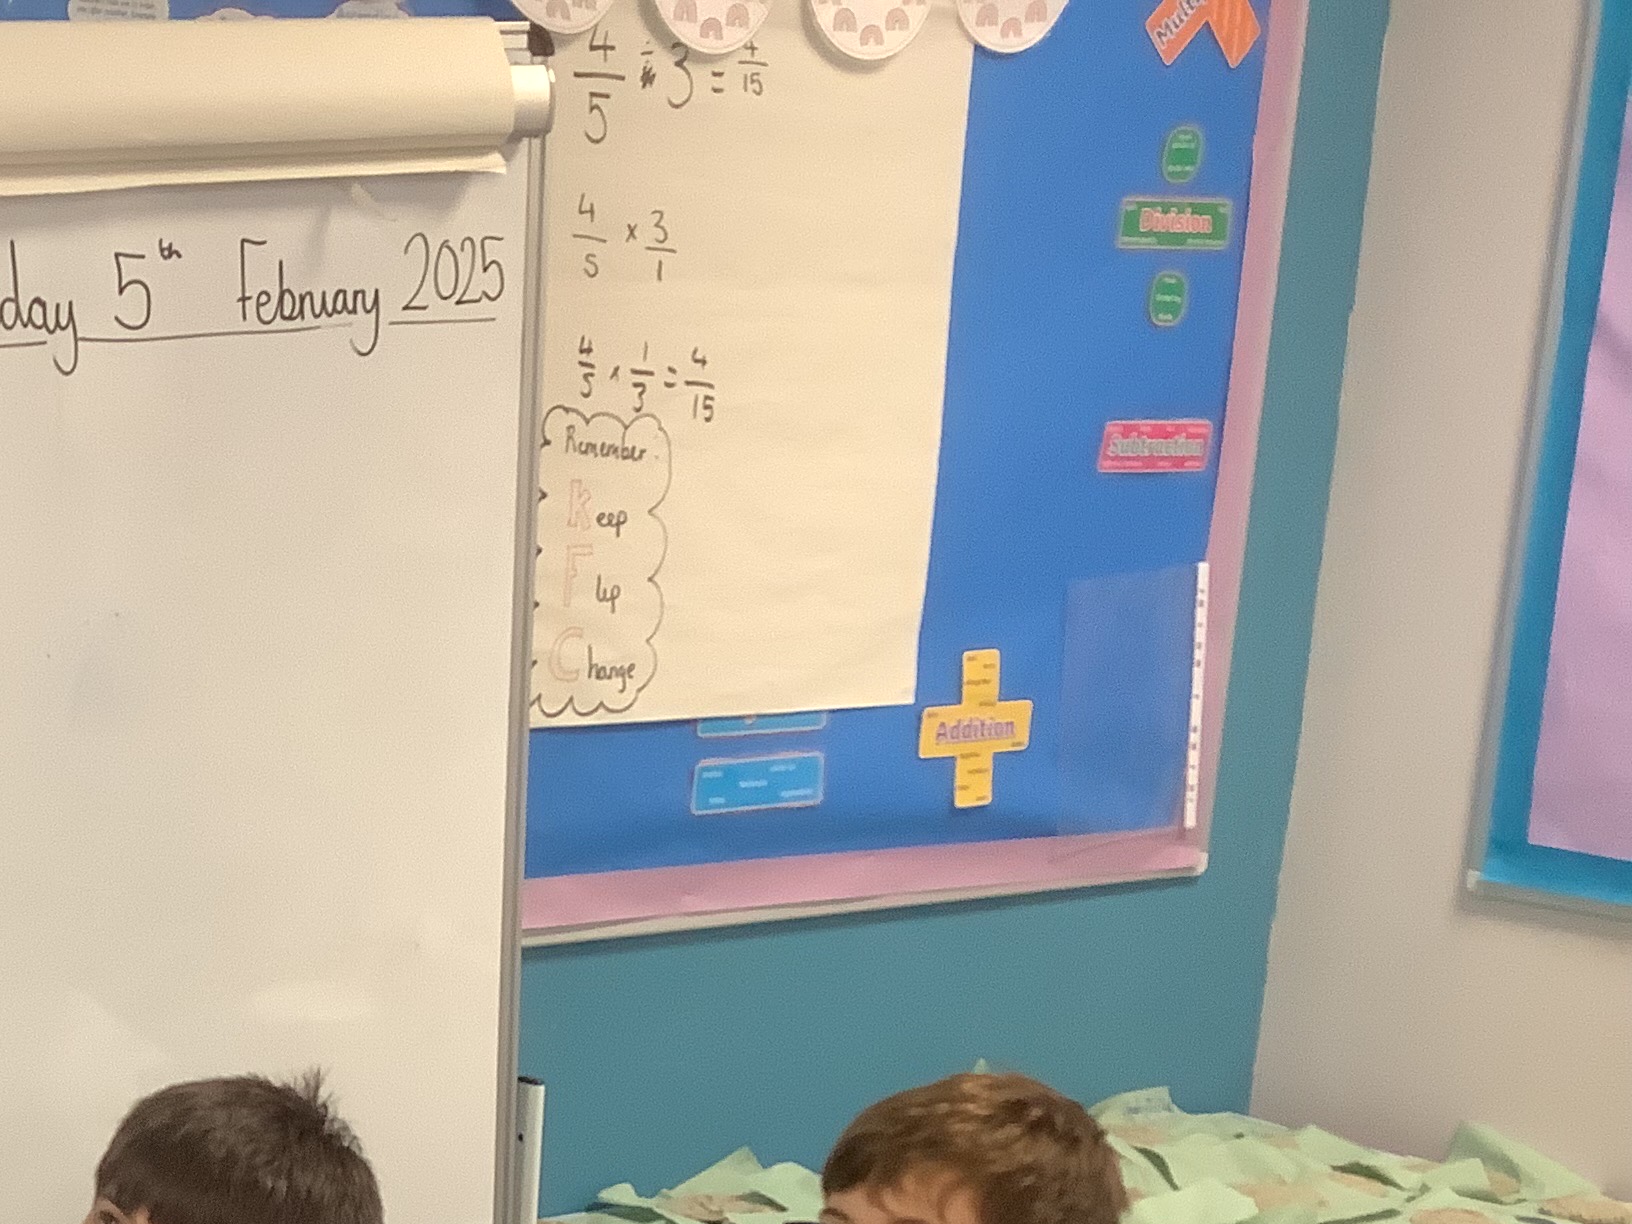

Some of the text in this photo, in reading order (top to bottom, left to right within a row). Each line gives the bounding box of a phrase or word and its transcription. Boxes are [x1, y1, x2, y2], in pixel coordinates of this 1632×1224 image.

[1139, 207, 1213, 233] Division
[238, 238, 382, 357] February
[401, 232, 506, 311] 2025
[565, 425, 646, 461] Remember
[935, 717, 1016, 742] Addition
